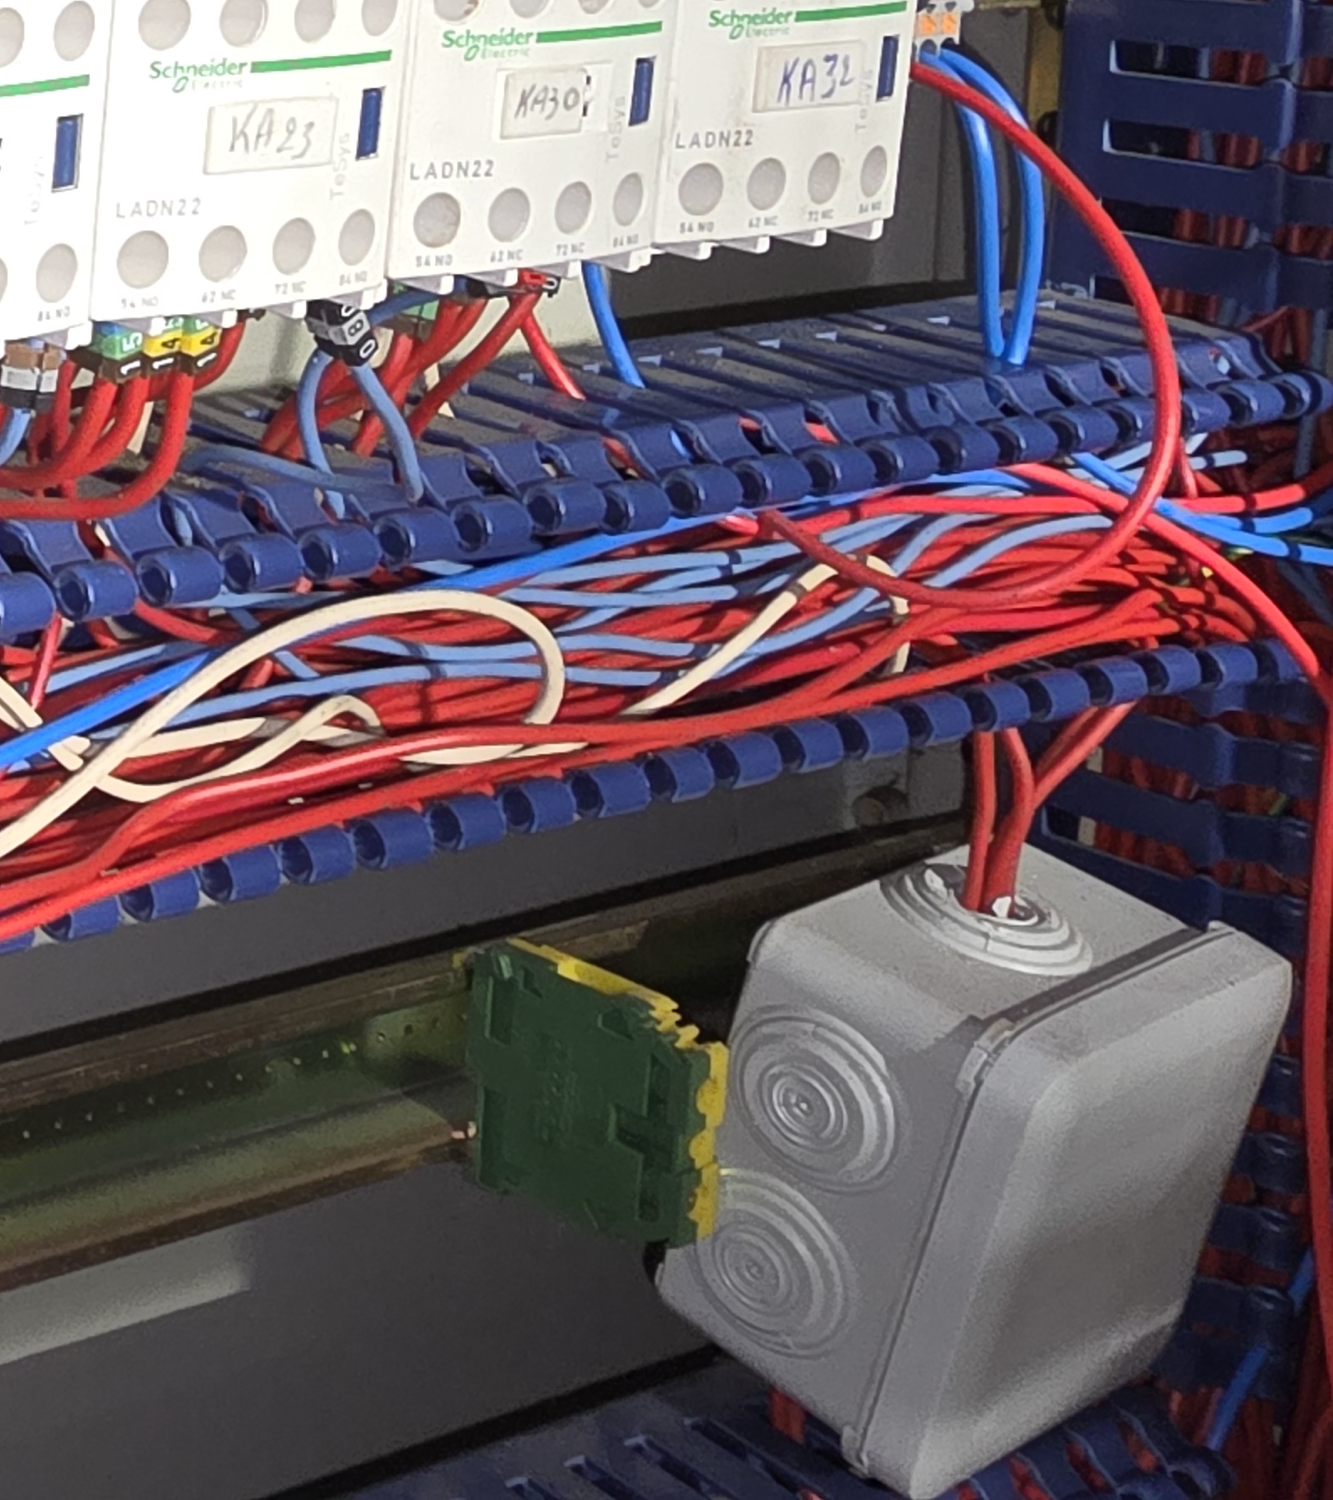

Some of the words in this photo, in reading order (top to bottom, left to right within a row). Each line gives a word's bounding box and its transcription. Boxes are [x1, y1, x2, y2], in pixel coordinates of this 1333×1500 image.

[708, 7, 793, 28] Schneider
[441, 27, 534, 49] Schneider
[149, 58, 248, 80] Schneider
[777, 53, 855, 107] KA32
[228, 101, 316, 161] KA23
[674, 128, 754, 150] LADN22
[409, 159, 495, 181] LADN22
[115, 197, 202, 219] LADN22
